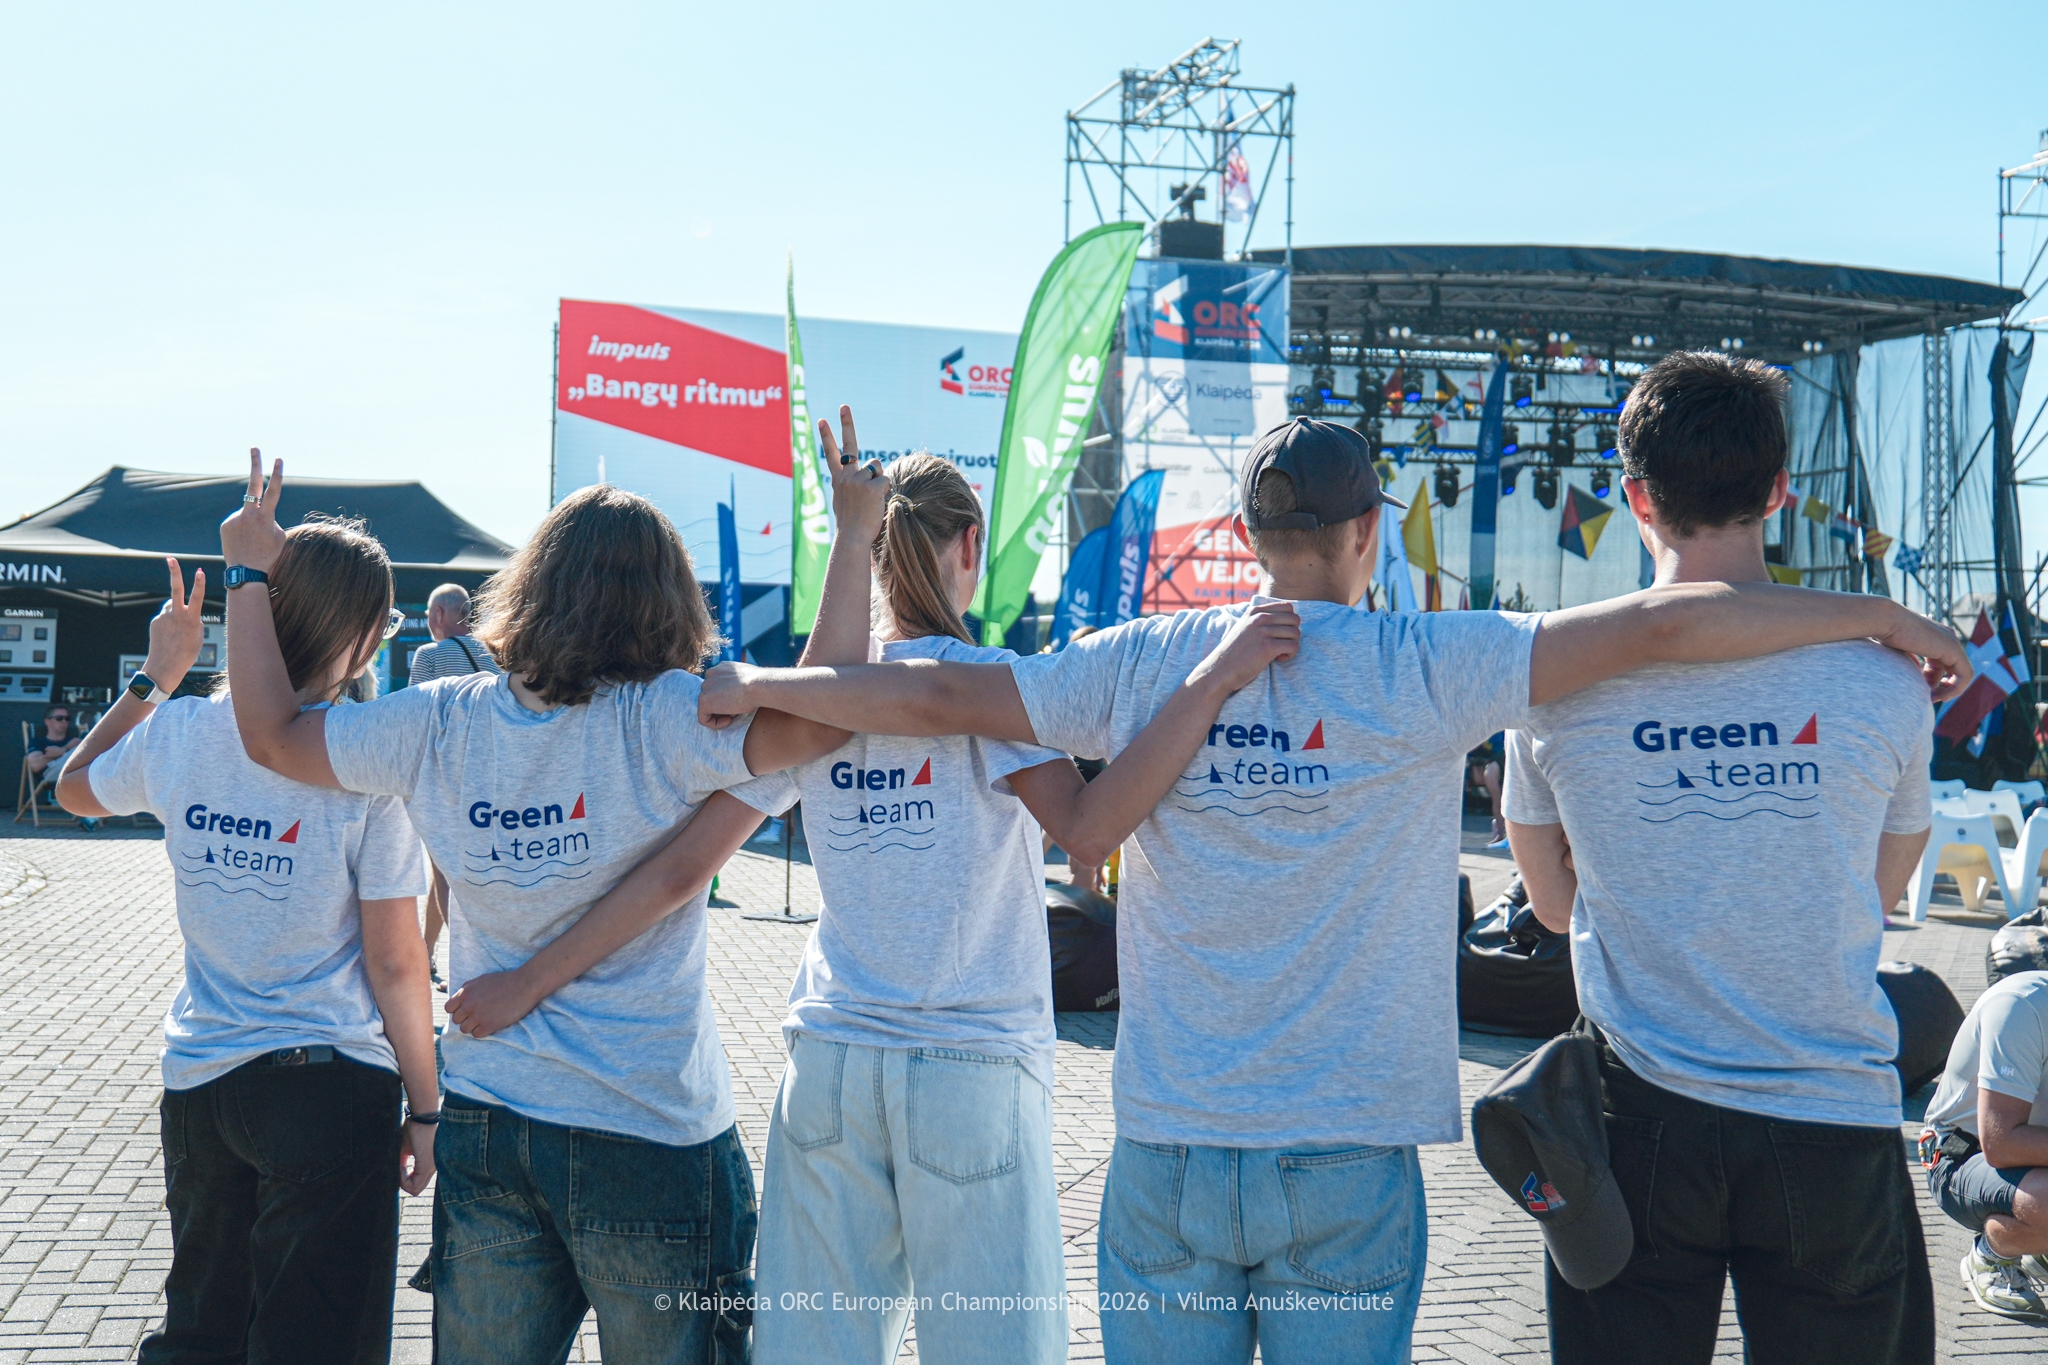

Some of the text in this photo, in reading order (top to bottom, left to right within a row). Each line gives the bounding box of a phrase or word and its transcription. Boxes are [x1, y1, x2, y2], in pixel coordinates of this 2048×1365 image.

[1193, 301, 1262, 328] ORC
[587, 334, 671, 362] impuls
[568, 373, 783, 408] „Bangų ritmu“
[1196, 383, 1262, 400] Klaipėda
[1194, 588, 1221, 598] FAIR
[4, 608, 44, 618] GARMIN
[1207, 723, 1290, 752] reen
[1632, 720, 1778, 752] Green
[1234, 758, 1329, 785] team
[1706, 759, 1819, 788] team
[185, 803, 272, 840] Green
[869, 799, 934, 825] eam
[222, 843, 293, 875] team
[511, 831, 589, 861] team
